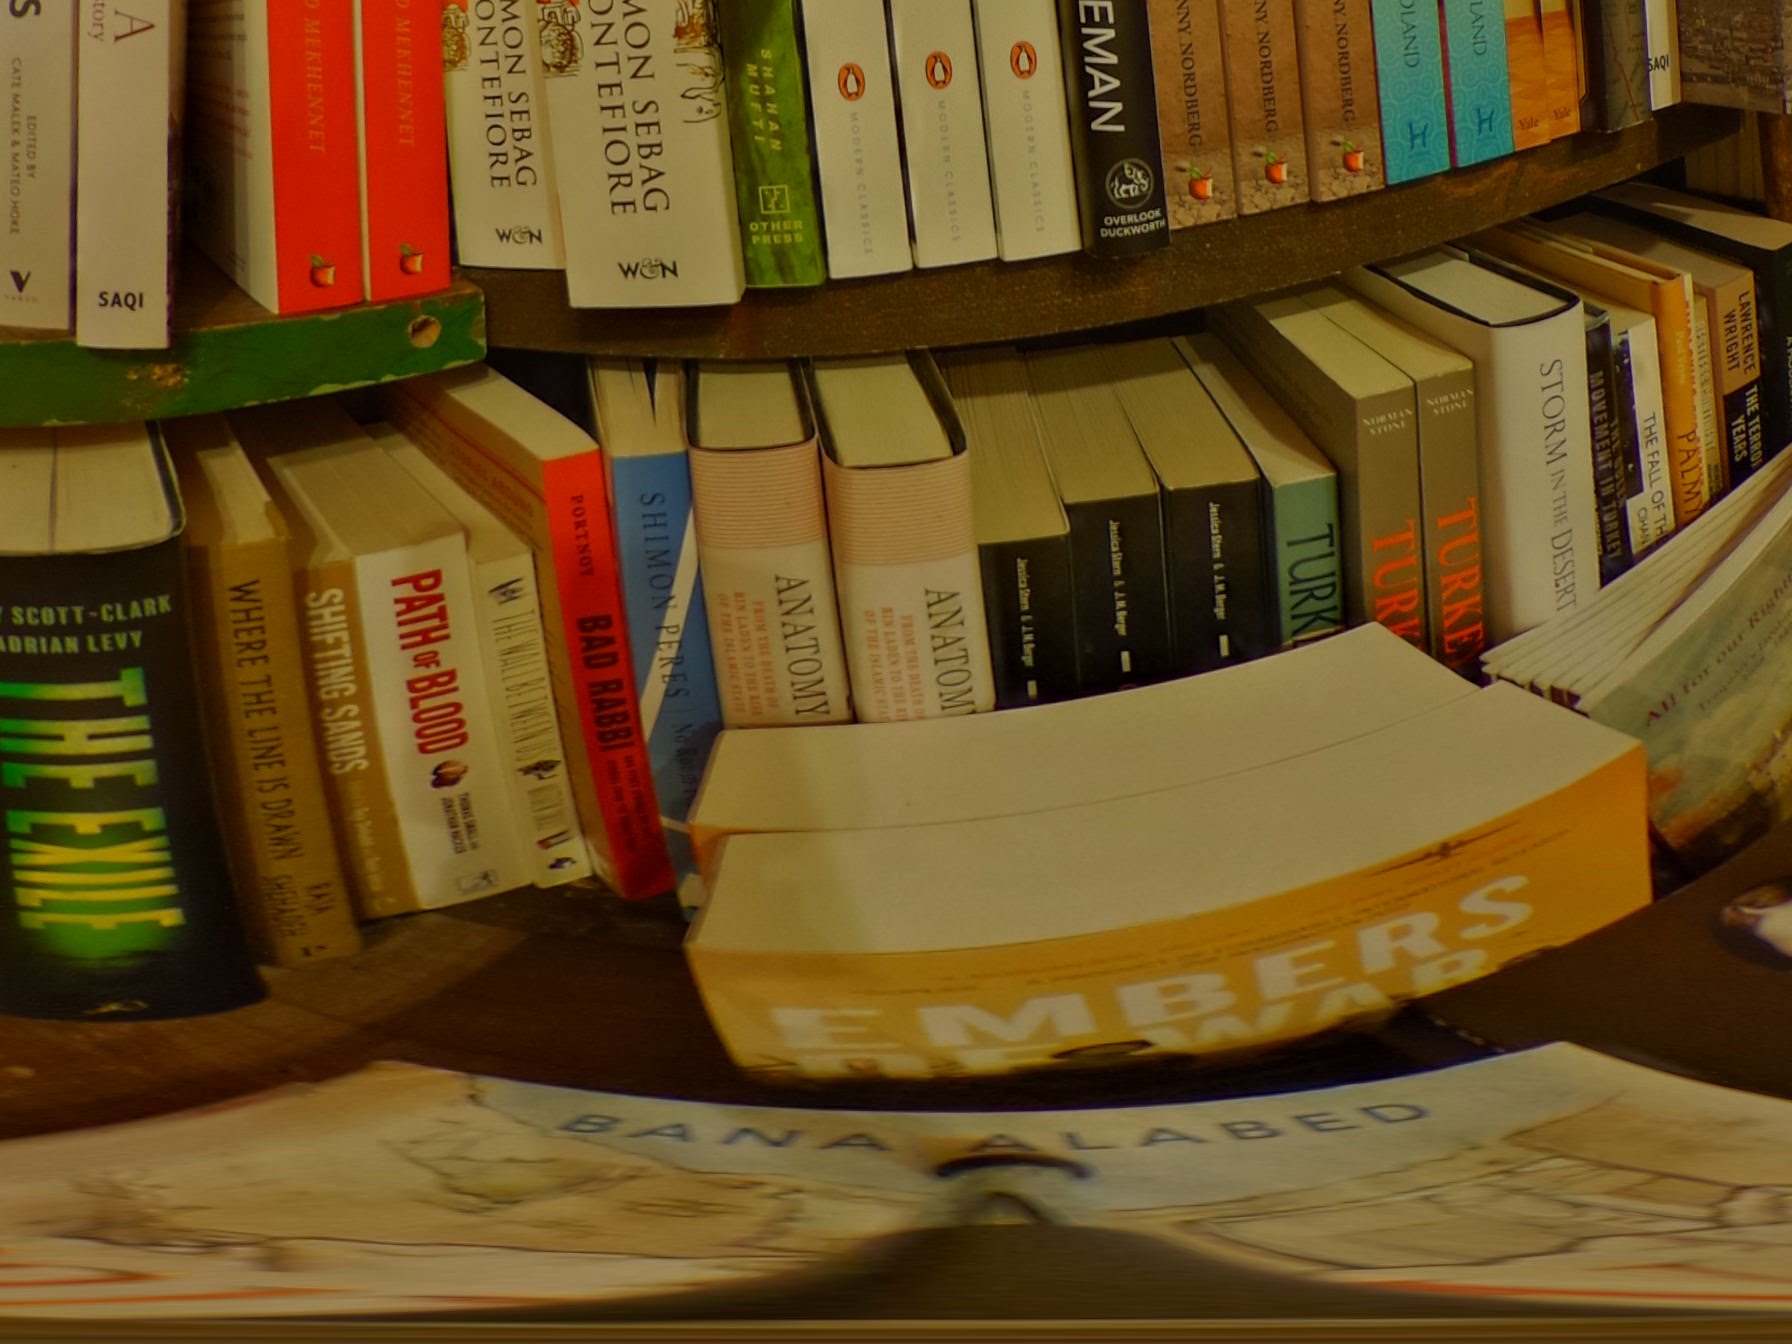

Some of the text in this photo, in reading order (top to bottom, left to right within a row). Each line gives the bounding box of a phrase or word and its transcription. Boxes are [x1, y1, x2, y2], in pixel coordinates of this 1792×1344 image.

[504, 91, 538, 188] SEBAG
[1177, 41, 1203, 148] NORDBERG
[631, 98, 671, 214] SEBAG
[97, 289, 146, 311] SAQI
[1723, 308, 1743, 372] WRIGHT
[1737, 290, 1757, 376] LAWRENCE
[1539, 358, 1579, 615] STORM DESERT
[1729, 415, 1750, 463] YEARS
[570, 493, 595, 579] PORTNOY
[10, 594, 174, 626] SCOTT-CLARK
[85, 630, 144, 652] LEVY
[639, 491, 688, 700] SHIMON PERES
[774, 573, 832, 719] ANATOMY
[303, 587, 370, 776] SHIFTING SANDS
[390, 568, 469, 757] PATH BLOOD
[576, 614, 636, 754] BAD RABBI
[227, 579, 306, 860] WHERE THE LINE DRAWN
[4, 807, 187, 930] EXILE
[768, 872, 1538, 1060] EMBERS
[558, 1100, 1431, 1156] BANA ALABED
